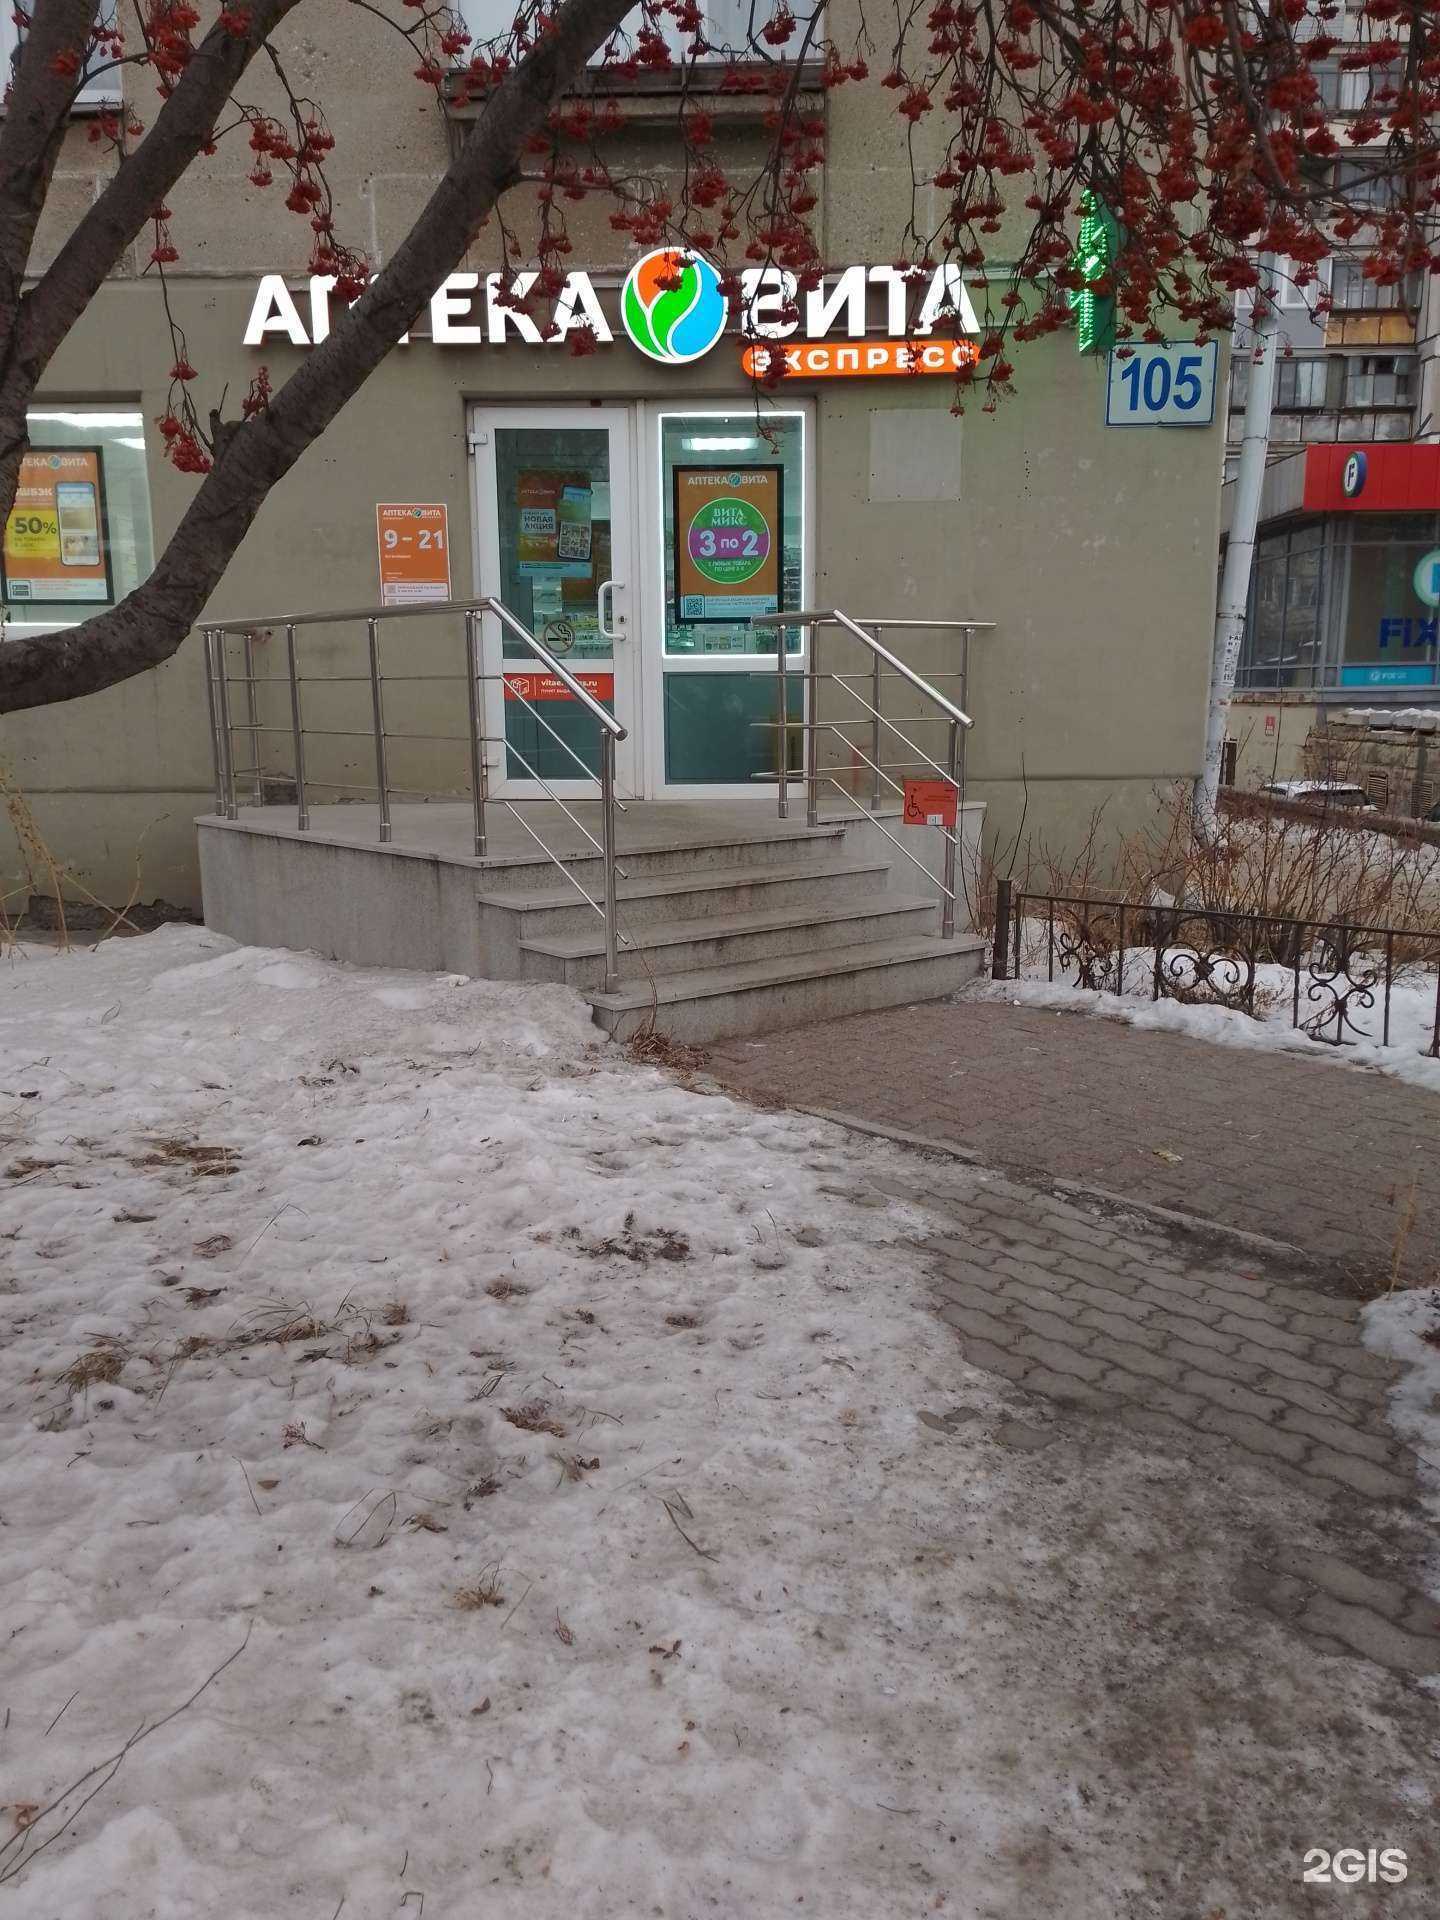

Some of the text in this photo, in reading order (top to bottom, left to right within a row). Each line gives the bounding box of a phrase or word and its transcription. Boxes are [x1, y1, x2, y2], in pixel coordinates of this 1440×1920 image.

[242, 263, 981, 344] АПЕКА ВИТА
[750, 347, 976, 372] ЭКСПРЕСС
[1121, 356, 1202, 411] 105
[687, 474, 768, 485] АПТЕКА ВИТА
[382, 509, 442, 517] АПТЕКА ВИТА
[713, 507, 745, 518] ВИТА
[384, 529, 399, 549] 9
[418, 529, 444, 549] 21
[699, 530, 717, 557] 3
[741, 529, 759, 556] 2
[1379, 617, 1439, 649] FIX
